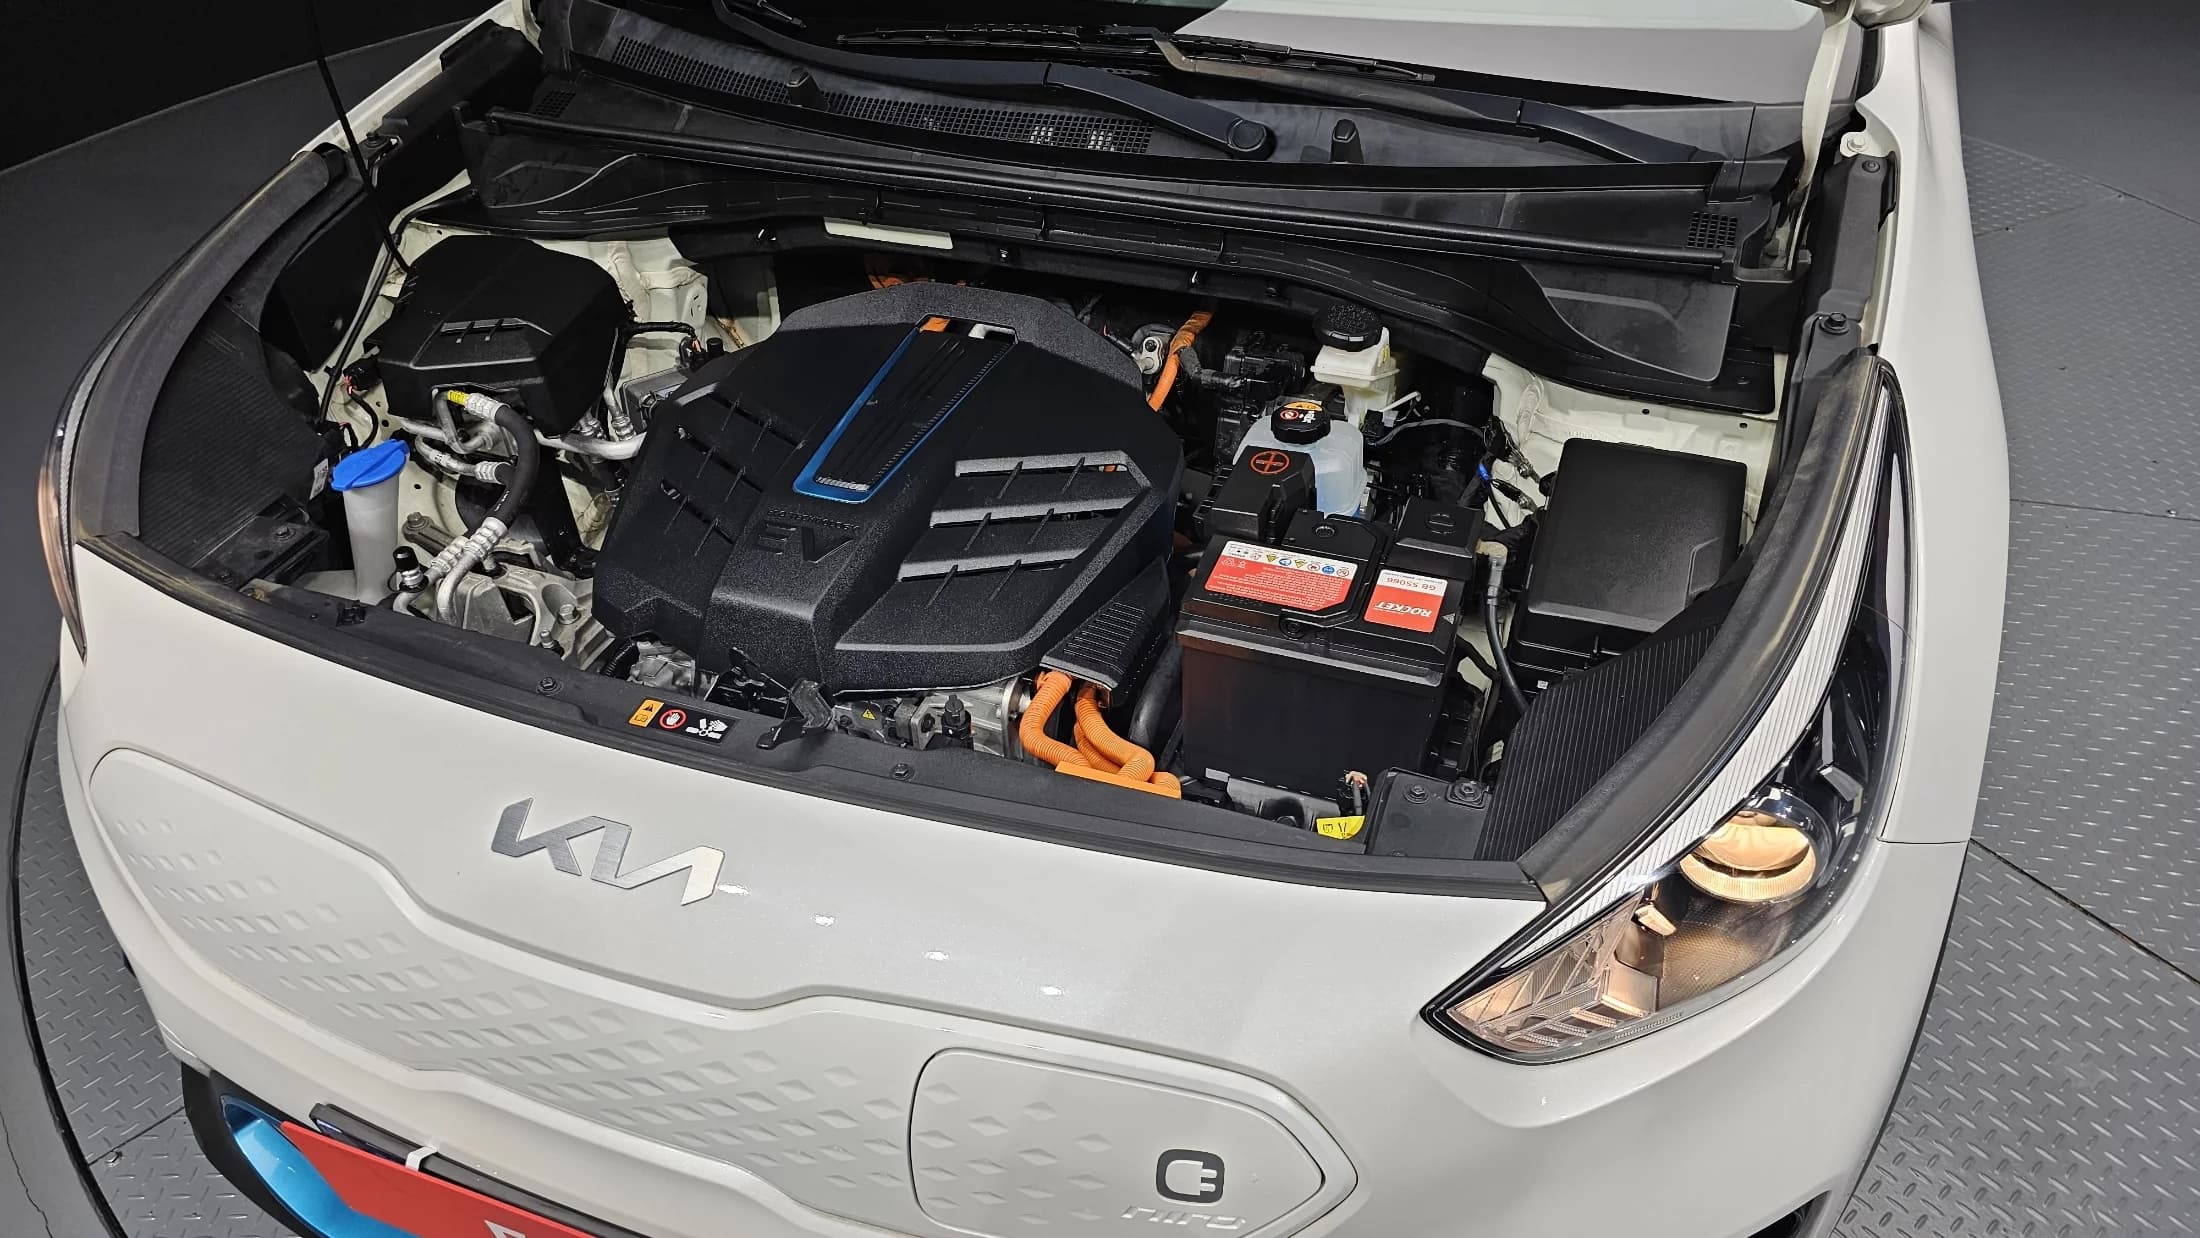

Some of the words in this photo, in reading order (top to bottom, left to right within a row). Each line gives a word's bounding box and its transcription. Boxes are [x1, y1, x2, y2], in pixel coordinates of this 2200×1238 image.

[752, 520, 855, 564] EV
[1374, 601, 1432, 617] ROCKET
[491, 797, 725, 906] KIA
